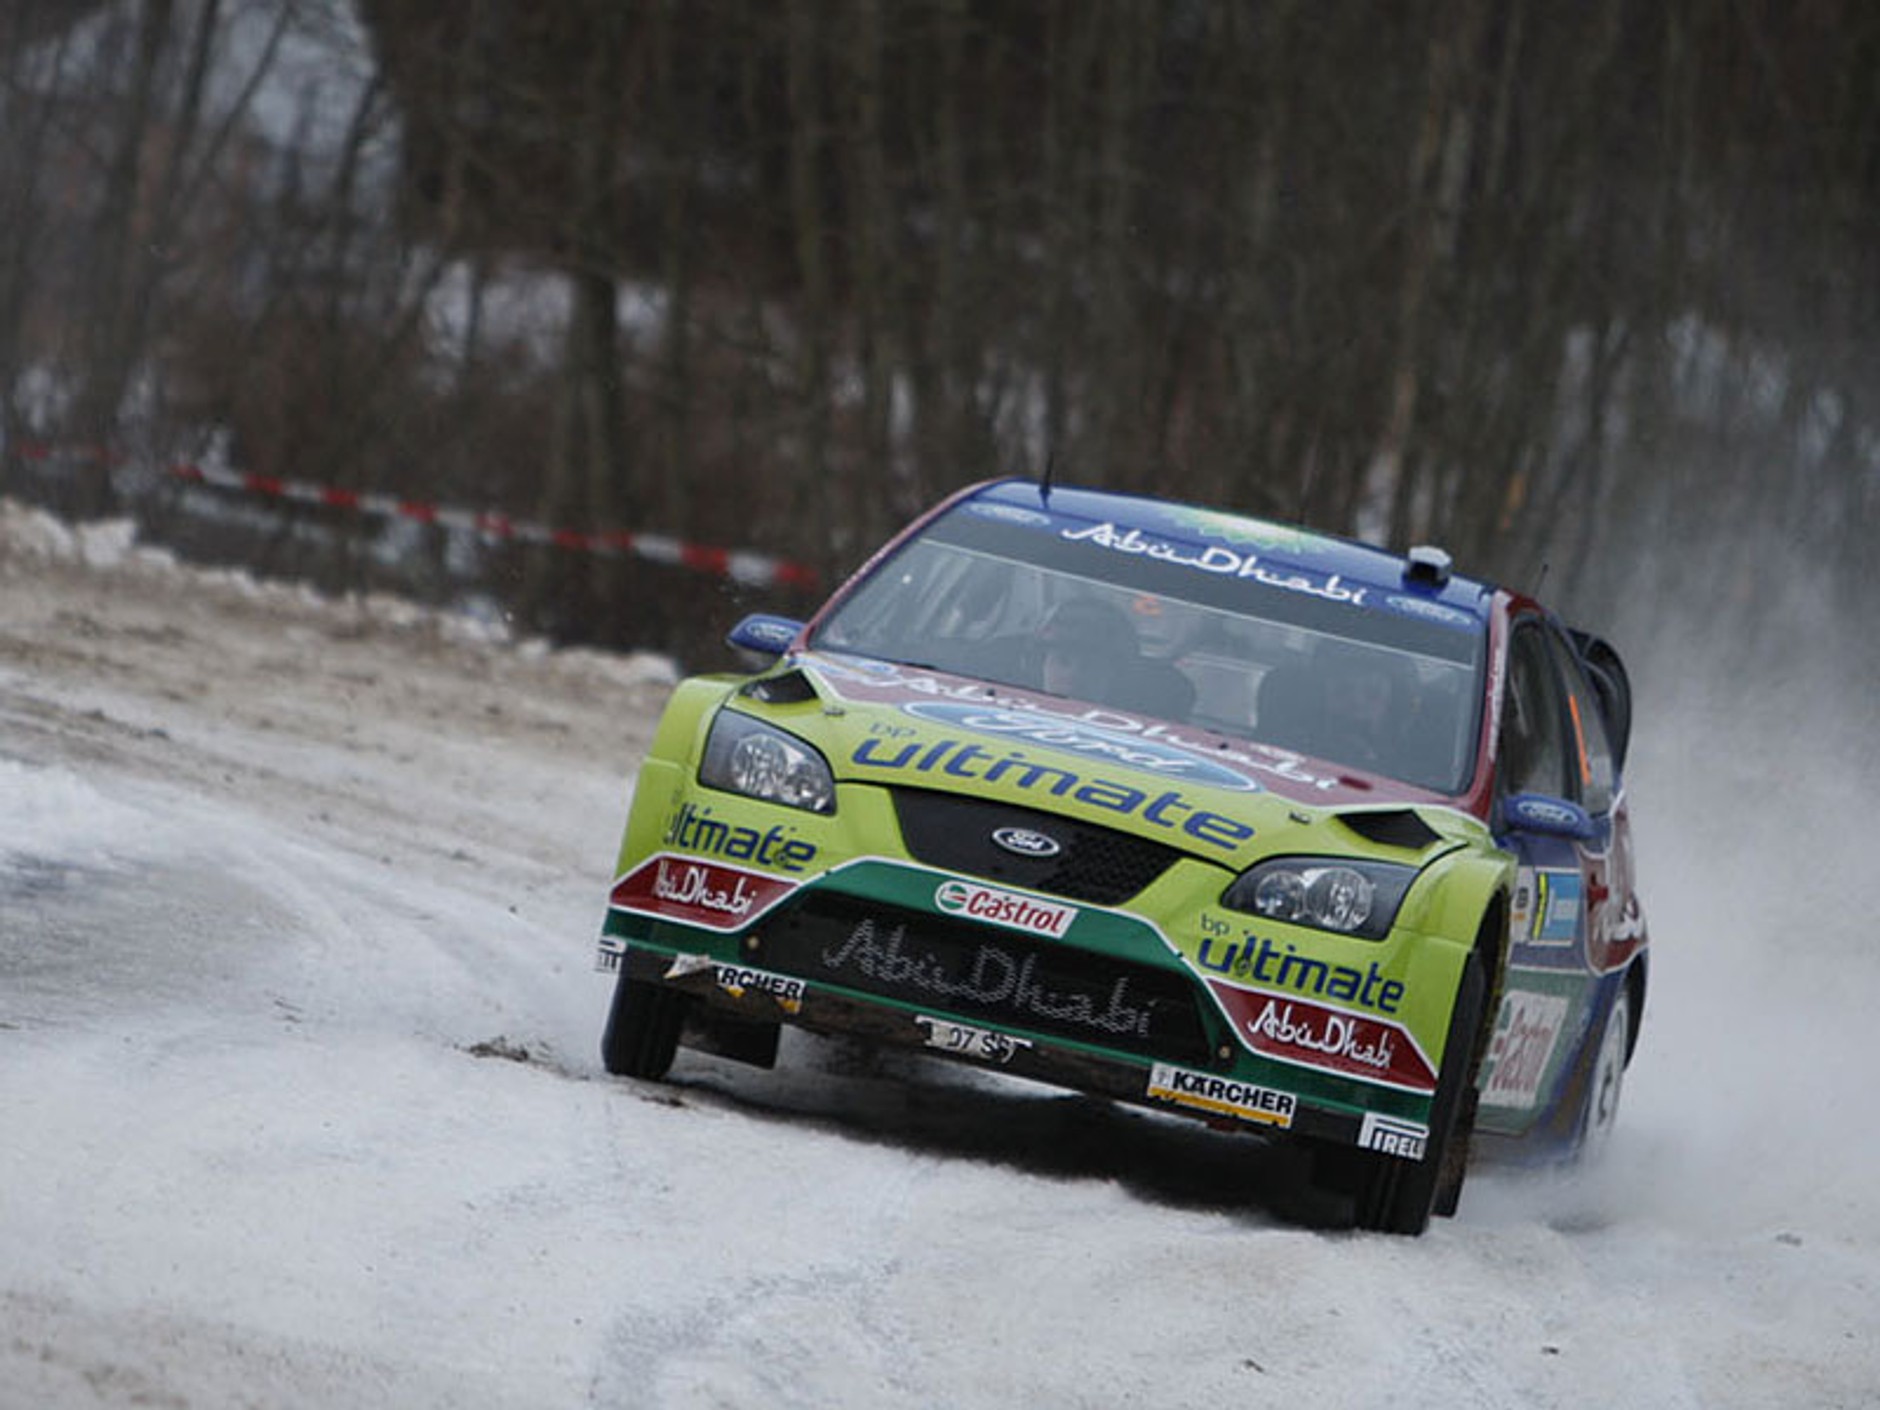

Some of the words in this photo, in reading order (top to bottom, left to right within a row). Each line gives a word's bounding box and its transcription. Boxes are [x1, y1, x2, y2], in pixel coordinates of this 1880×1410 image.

[961, 711, 1198, 773] Ford
[851, 737, 1256, 851] ultimate
[967, 890, 1065, 933] Castrol
[1200, 914, 1230, 936] bp
[715, 966, 802, 998] RCHER
[1198, 934, 1405, 1013] ultimate
